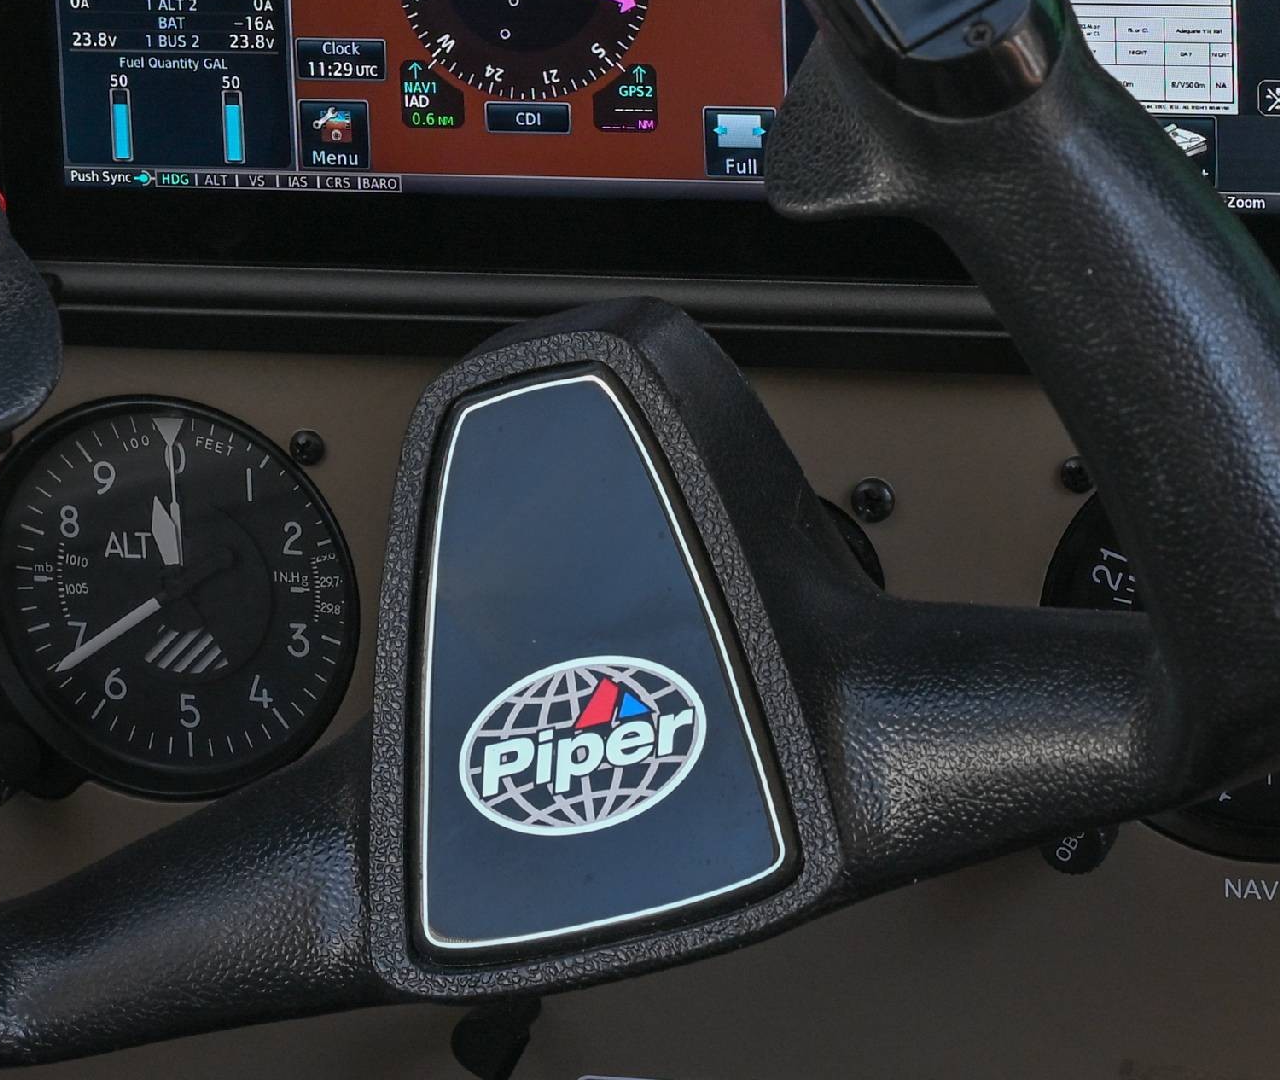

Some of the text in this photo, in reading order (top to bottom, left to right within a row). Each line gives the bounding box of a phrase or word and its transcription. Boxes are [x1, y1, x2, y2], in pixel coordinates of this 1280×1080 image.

[322, 42, 360, 56] Clock
[308, 62, 378, 77] 11:29 UTC
[312, 151, 358, 165] Menu
[726, 158, 758, 175] Full
[195, 436, 234, 457] FEET
[104, 531, 152, 559] ALT
[482, 707, 695, 798] Piper
[1225, 878, 1279, 902] NAV
